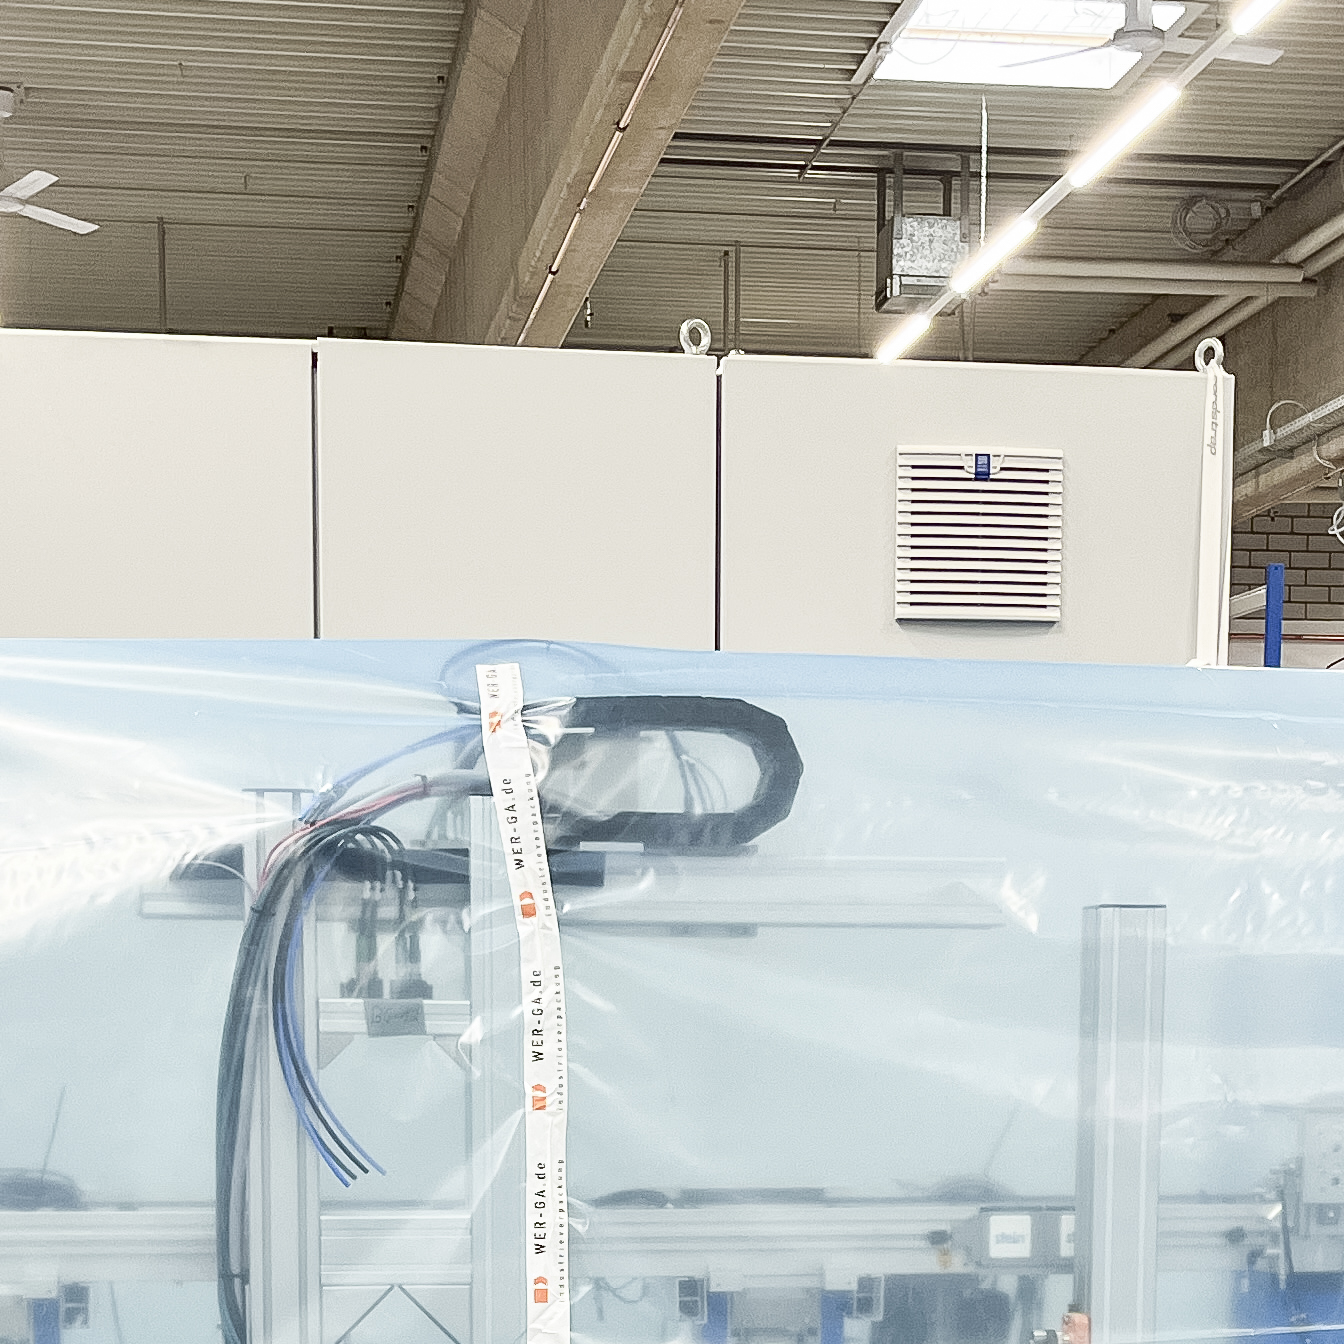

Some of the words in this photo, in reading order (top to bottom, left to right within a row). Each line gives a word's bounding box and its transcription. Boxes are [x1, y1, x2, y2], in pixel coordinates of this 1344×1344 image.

[501, 778, 524, 871] WER-GA.de
[530, 969, 544, 1063] WER-GA.de
[534, 1162, 547, 1255] WER-GA.de
